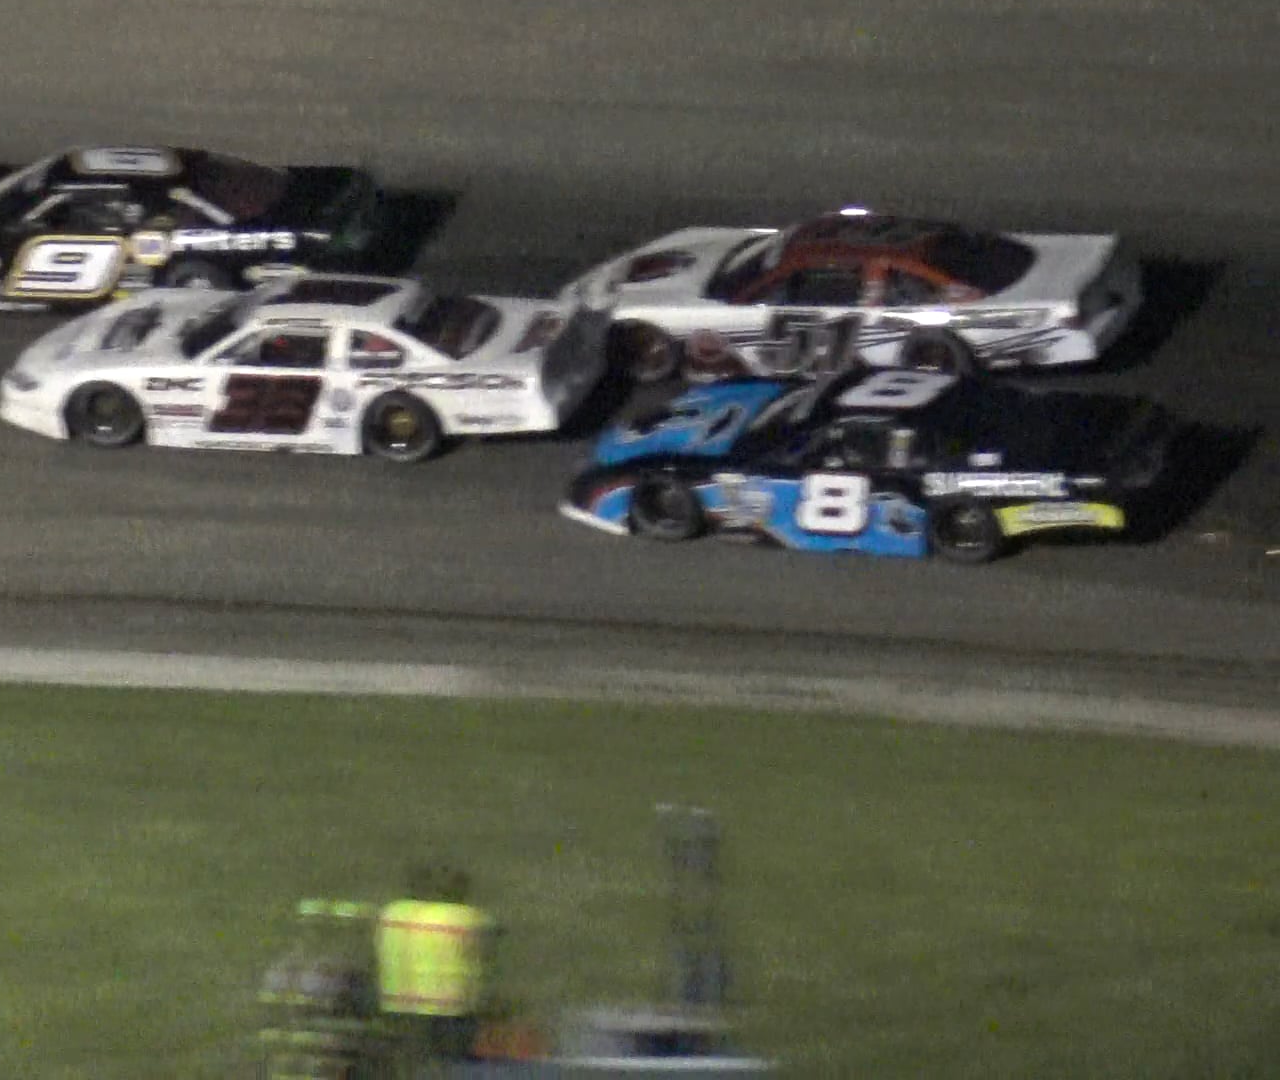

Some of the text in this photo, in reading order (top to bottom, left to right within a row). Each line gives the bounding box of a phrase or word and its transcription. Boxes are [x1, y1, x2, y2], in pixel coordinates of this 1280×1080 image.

[12, 237, 123, 296] 9
[838, 370, 954, 407] 8
[796, 473, 871, 533] 8
